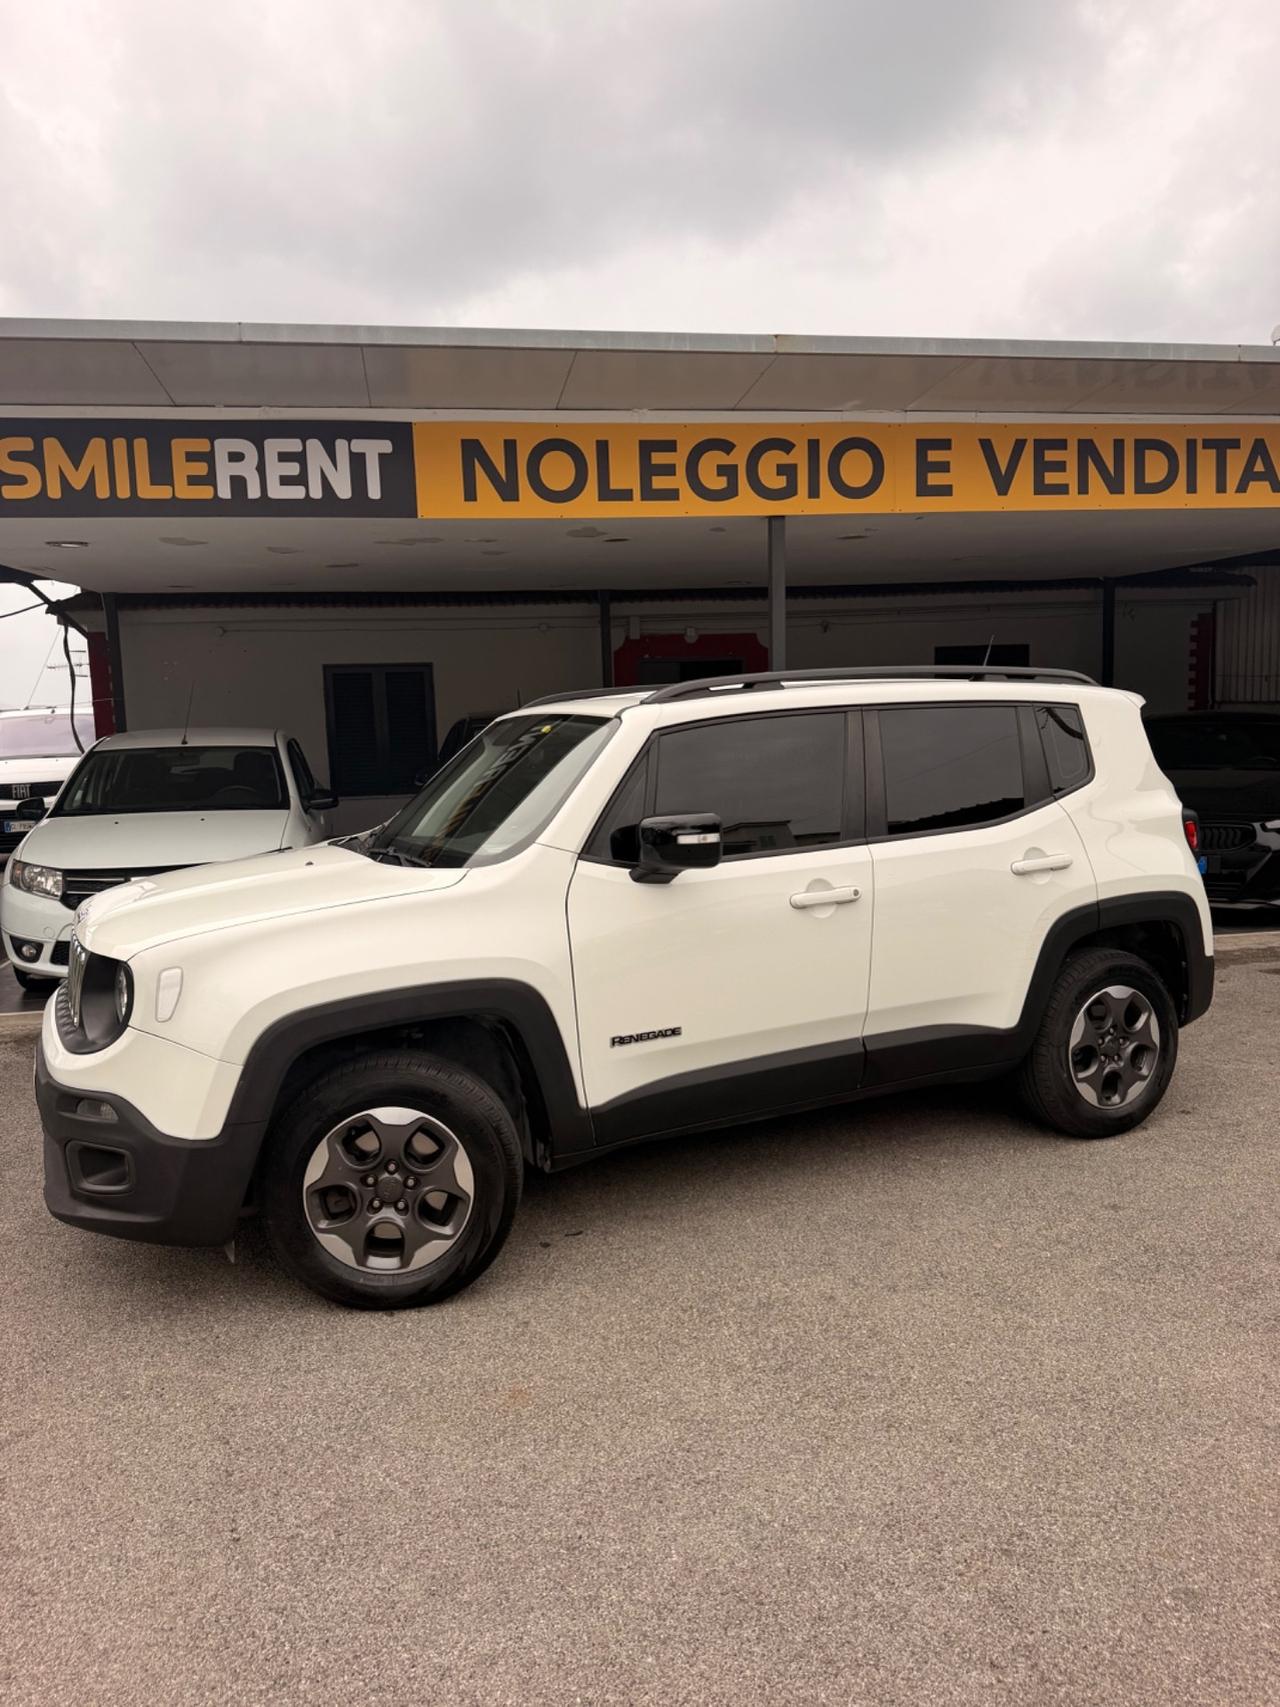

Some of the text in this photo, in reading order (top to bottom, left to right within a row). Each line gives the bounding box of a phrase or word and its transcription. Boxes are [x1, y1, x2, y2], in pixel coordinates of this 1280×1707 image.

[0, 436, 393, 500] SMILERENT
[461, 436, 1280, 505] NOLEGGIO E VENDITA
[12, 784, 31, 799] FIAT
[610, 1026, 682, 1048] RENEGADE
